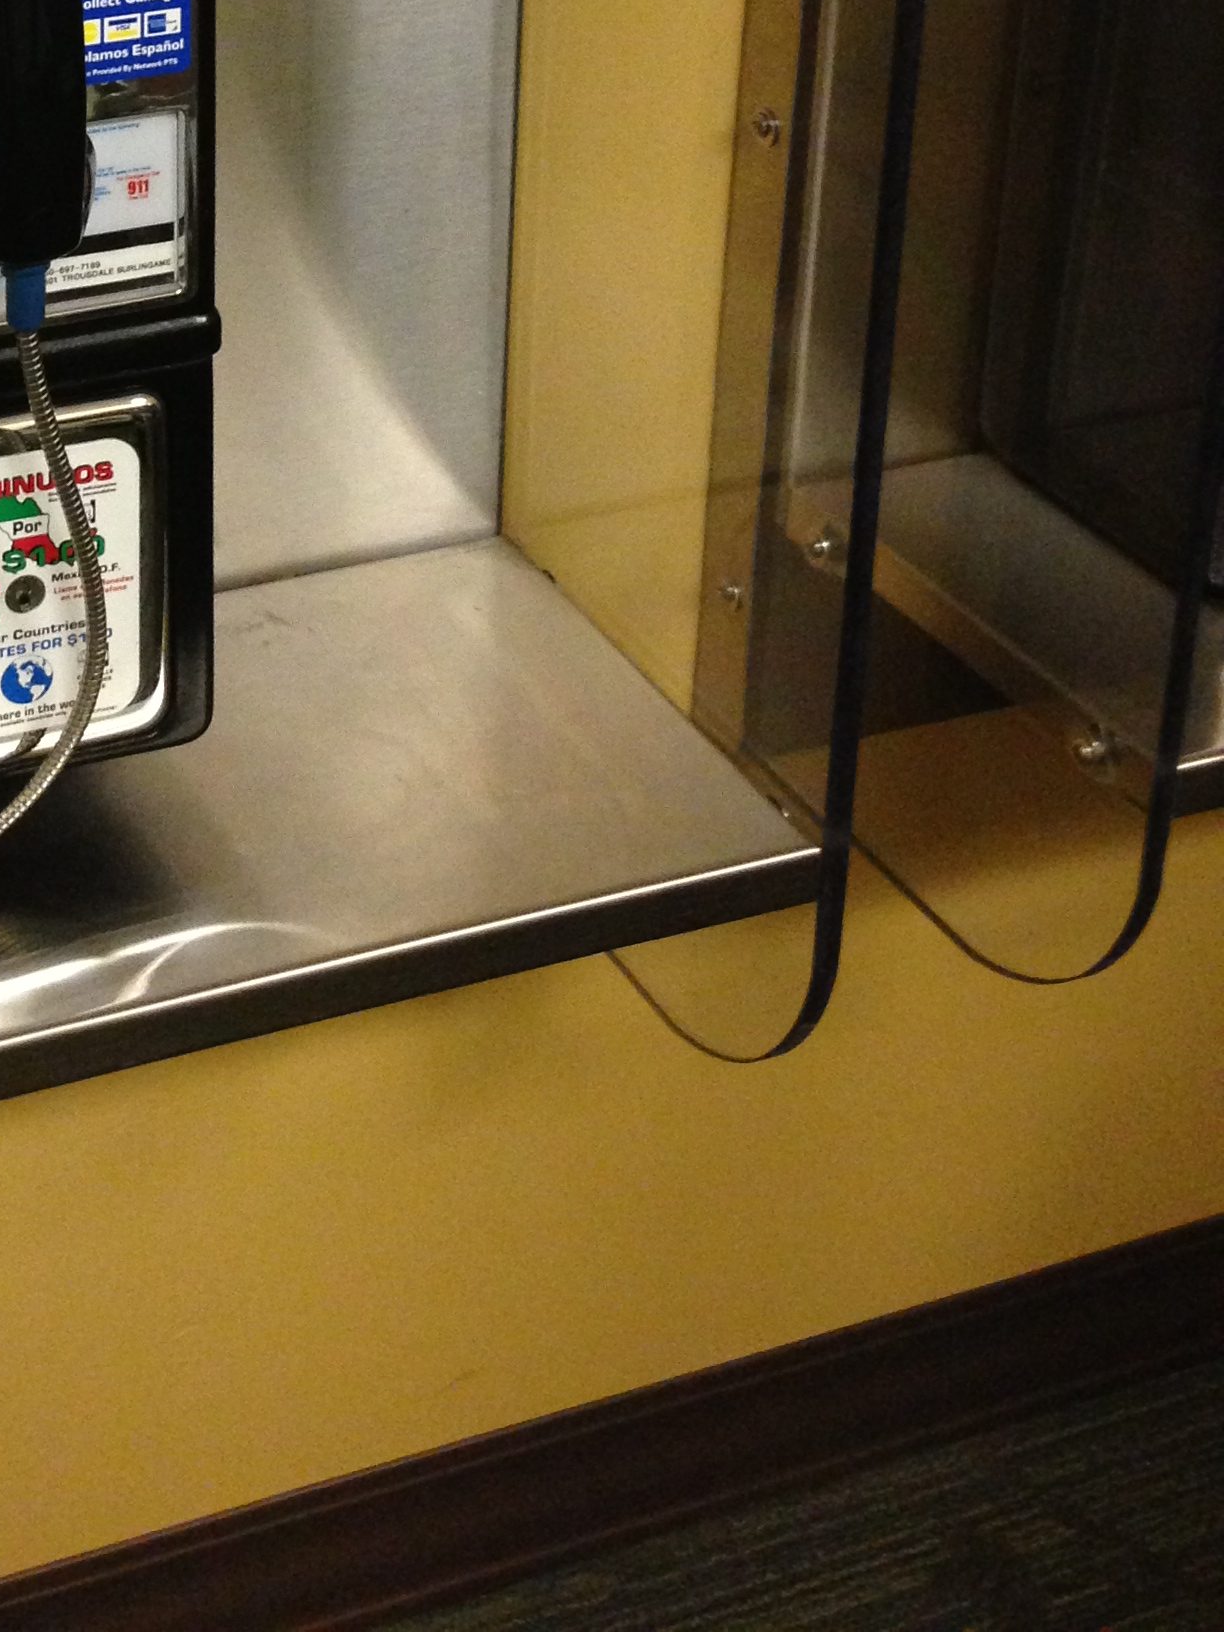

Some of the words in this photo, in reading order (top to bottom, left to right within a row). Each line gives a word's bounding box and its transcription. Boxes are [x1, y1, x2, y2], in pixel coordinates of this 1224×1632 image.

[85, 48, 130, 63] lamos
[132, 37, 184, 58] Español
[128, 179, 149, 195] 911
[62, 268, 114, 282] TROUSDALE
[117, 258, 171, 273] BURLINGAME
[12, 520, 42, 536] Por
[13, 620, 86, 640] Countries
[31, 637, 62, 652] FOR
[24, 706, 35, 716] in
[38, 703, 56, 714] the
